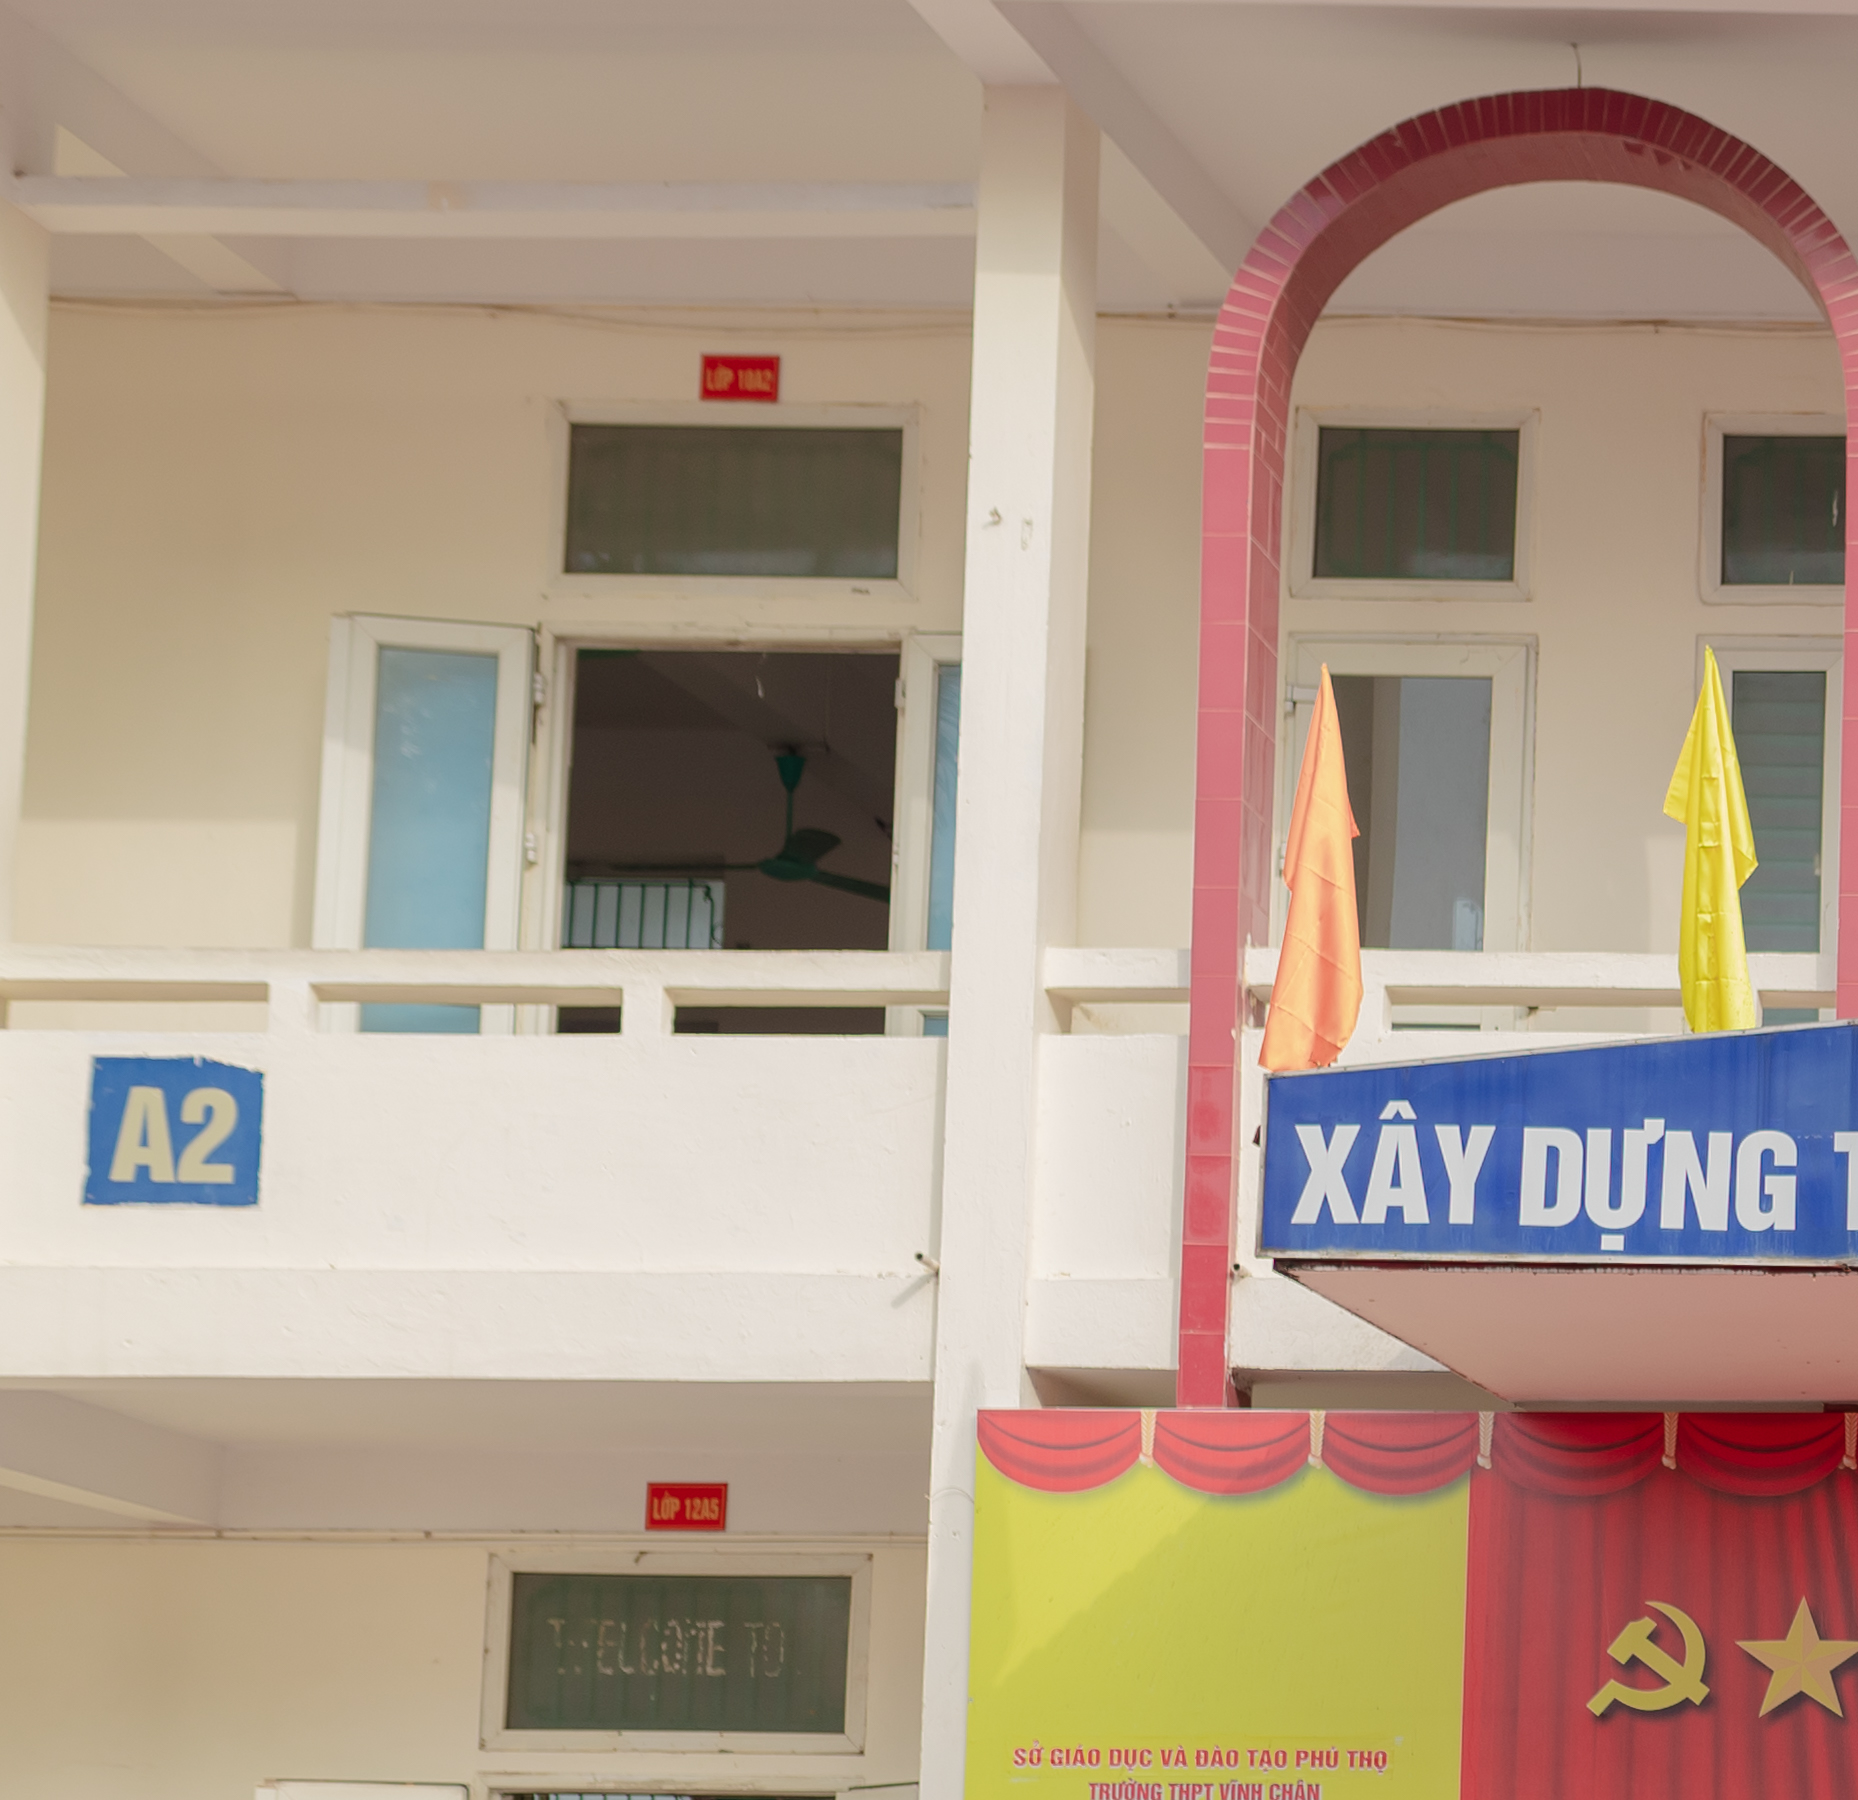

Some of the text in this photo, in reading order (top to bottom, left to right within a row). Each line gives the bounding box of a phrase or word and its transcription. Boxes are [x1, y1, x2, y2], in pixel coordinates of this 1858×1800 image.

[108, 1085, 238, 1184] A2
[1291, 1100, 1495, 1227] XÂY
[1519, 1118, 1798, 1252] DỰNG
[652, 1490, 720, 1521] LỚP 12A5
[1013, 1740, 1044, 1768] SỞ
[1050, 1742, 1101, 1768] GIÁO
[1109, 1748, 1153, 1772] DỤC
[1160, 1745, 1188, 1769] VÀ
[1195, 1745, 1239, 1769] ĐÀO
[1247, 1749, 1288, 1773] TẠO
[1347, 1749, 1389, 1775] THỌ
